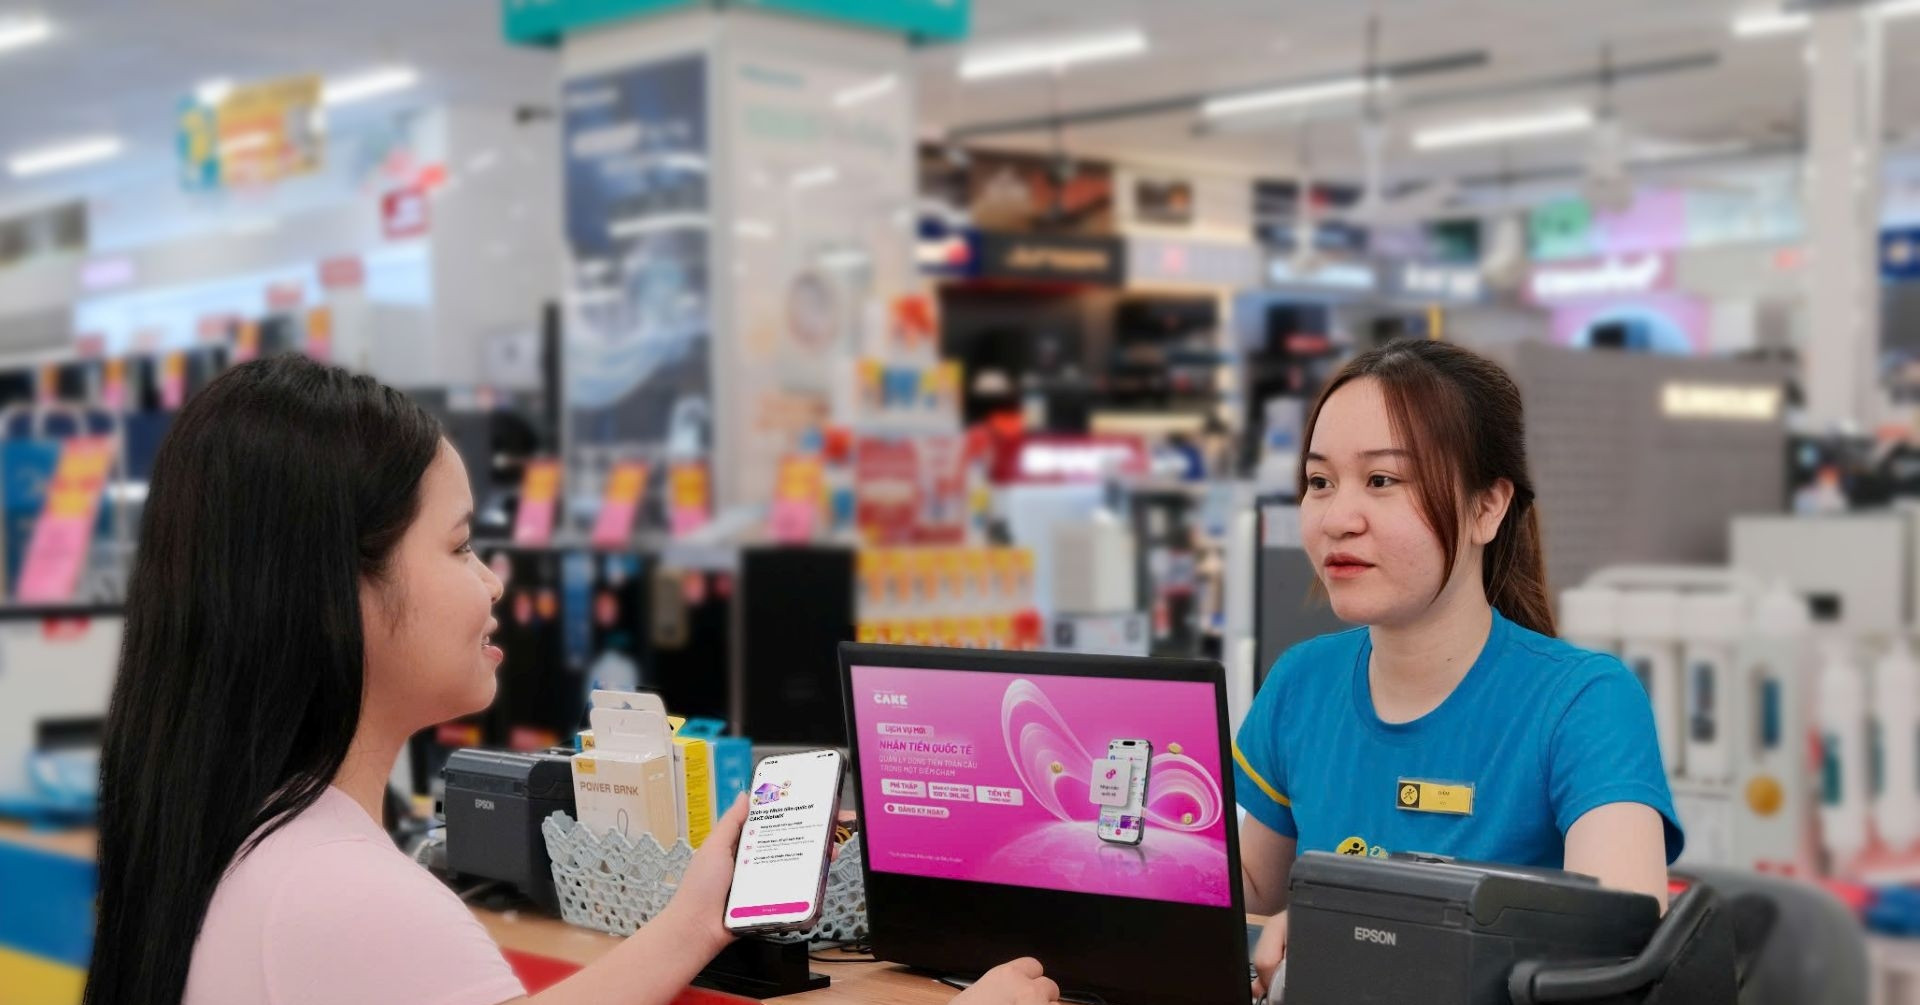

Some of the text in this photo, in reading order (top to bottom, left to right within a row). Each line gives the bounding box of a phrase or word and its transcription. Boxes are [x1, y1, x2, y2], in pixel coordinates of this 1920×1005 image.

[873, 693, 908, 705] CAKE
[879, 740, 906, 752] NHẬN
[932, 742, 957, 755] QUỐC
[961, 744, 972, 755] TẾ
[580, 781, 639, 796] POWER BANK
[475, 799, 495, 811] EPSON
[1354, 926, 1396, 946] EPSON
